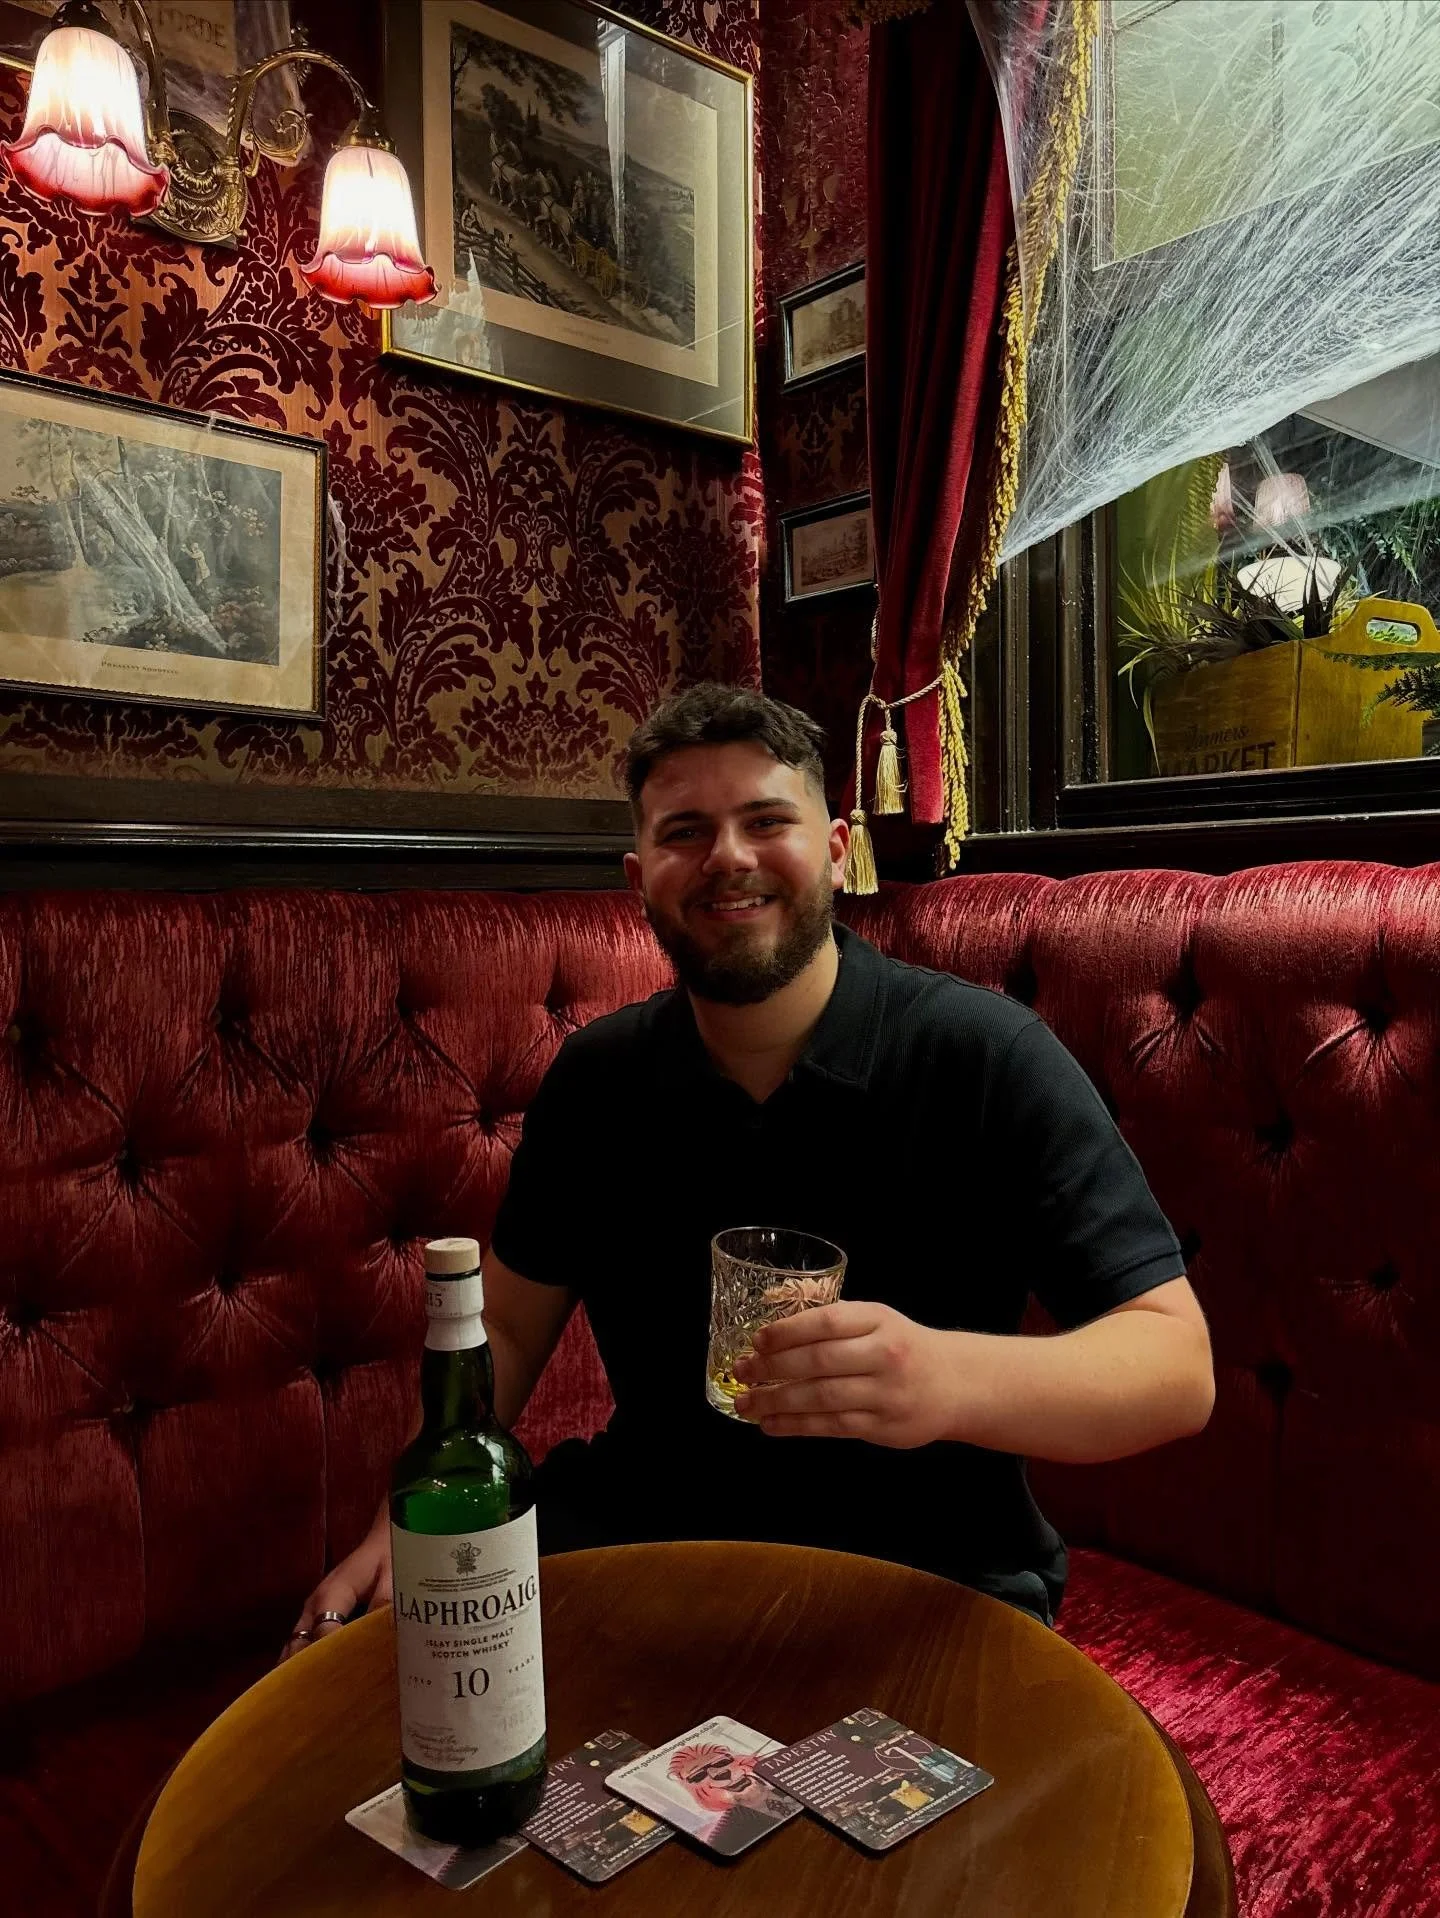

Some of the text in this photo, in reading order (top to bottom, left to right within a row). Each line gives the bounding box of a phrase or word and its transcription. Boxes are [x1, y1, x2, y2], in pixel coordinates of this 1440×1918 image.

[399, 1575, 537, 1626] LAPHROAIG
[424, 1627, 514, 1648] ISLAY SINGLE MALT
[431, 1640, 510, 1659] SCOTCH WHISKY
[452, 1667, 490, 1698] 10
[761, 1729, 837, 1770] TAPESTRY
